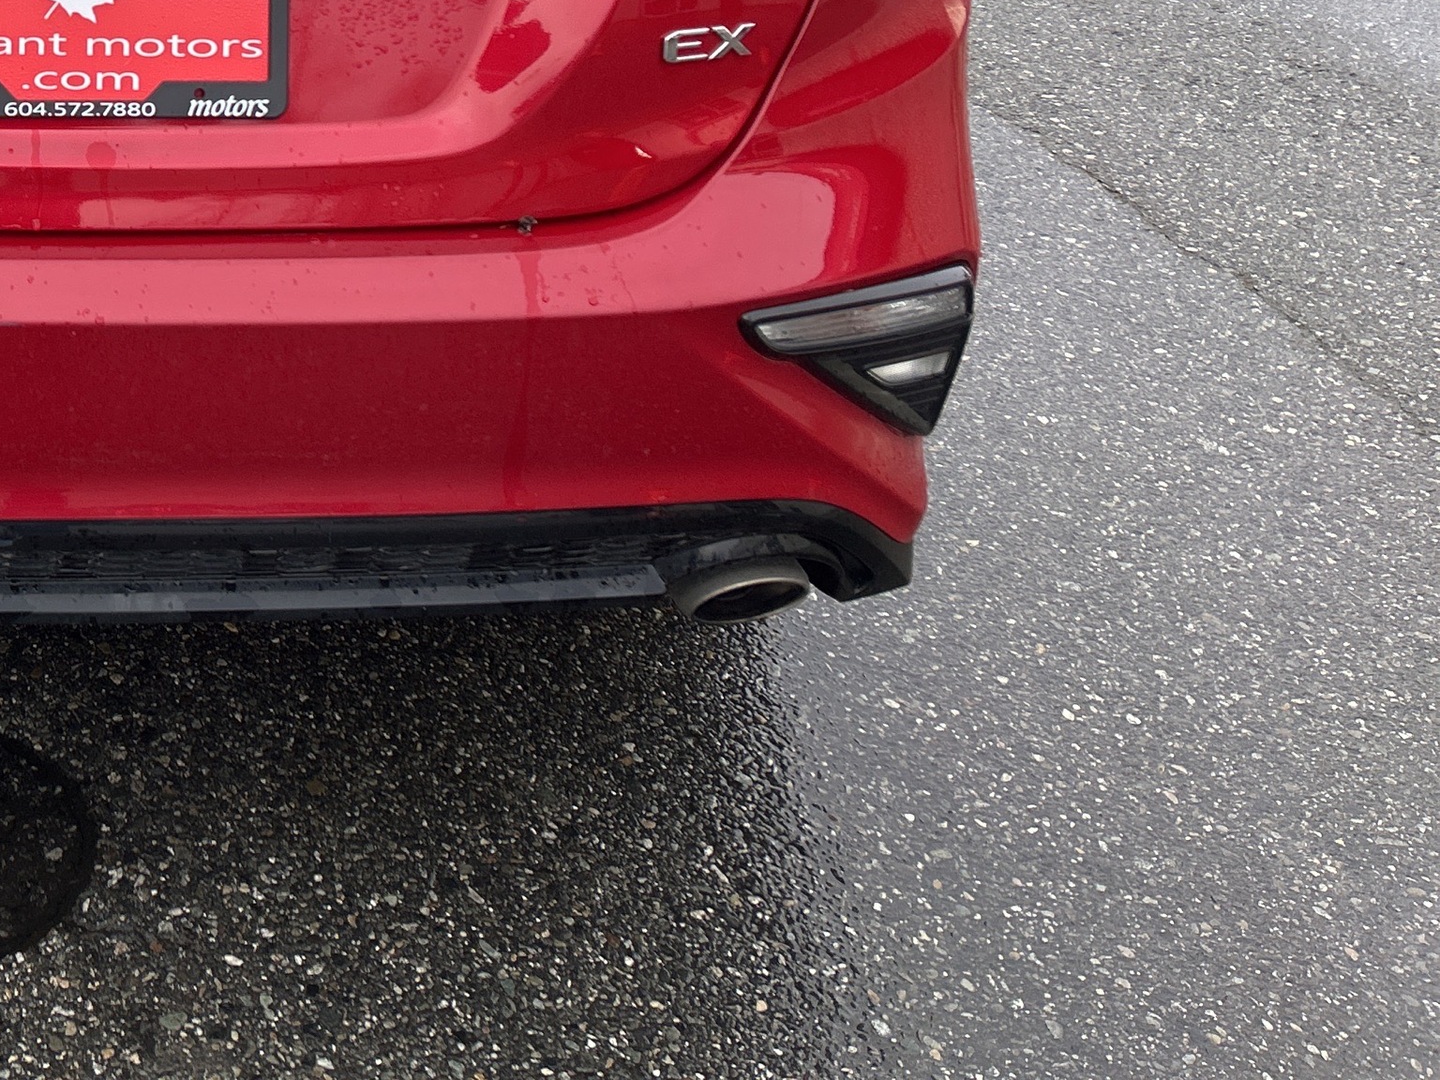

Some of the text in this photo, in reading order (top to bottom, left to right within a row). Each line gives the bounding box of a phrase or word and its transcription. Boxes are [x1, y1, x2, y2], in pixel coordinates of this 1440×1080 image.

[85, 33, 264, 58] motors
[662, 22, 756, 63] EX
[21, 69, 141, 91] .com
[3, 101, 157, 117] 604.572.7880
[187, 94, 270, 118] motors
